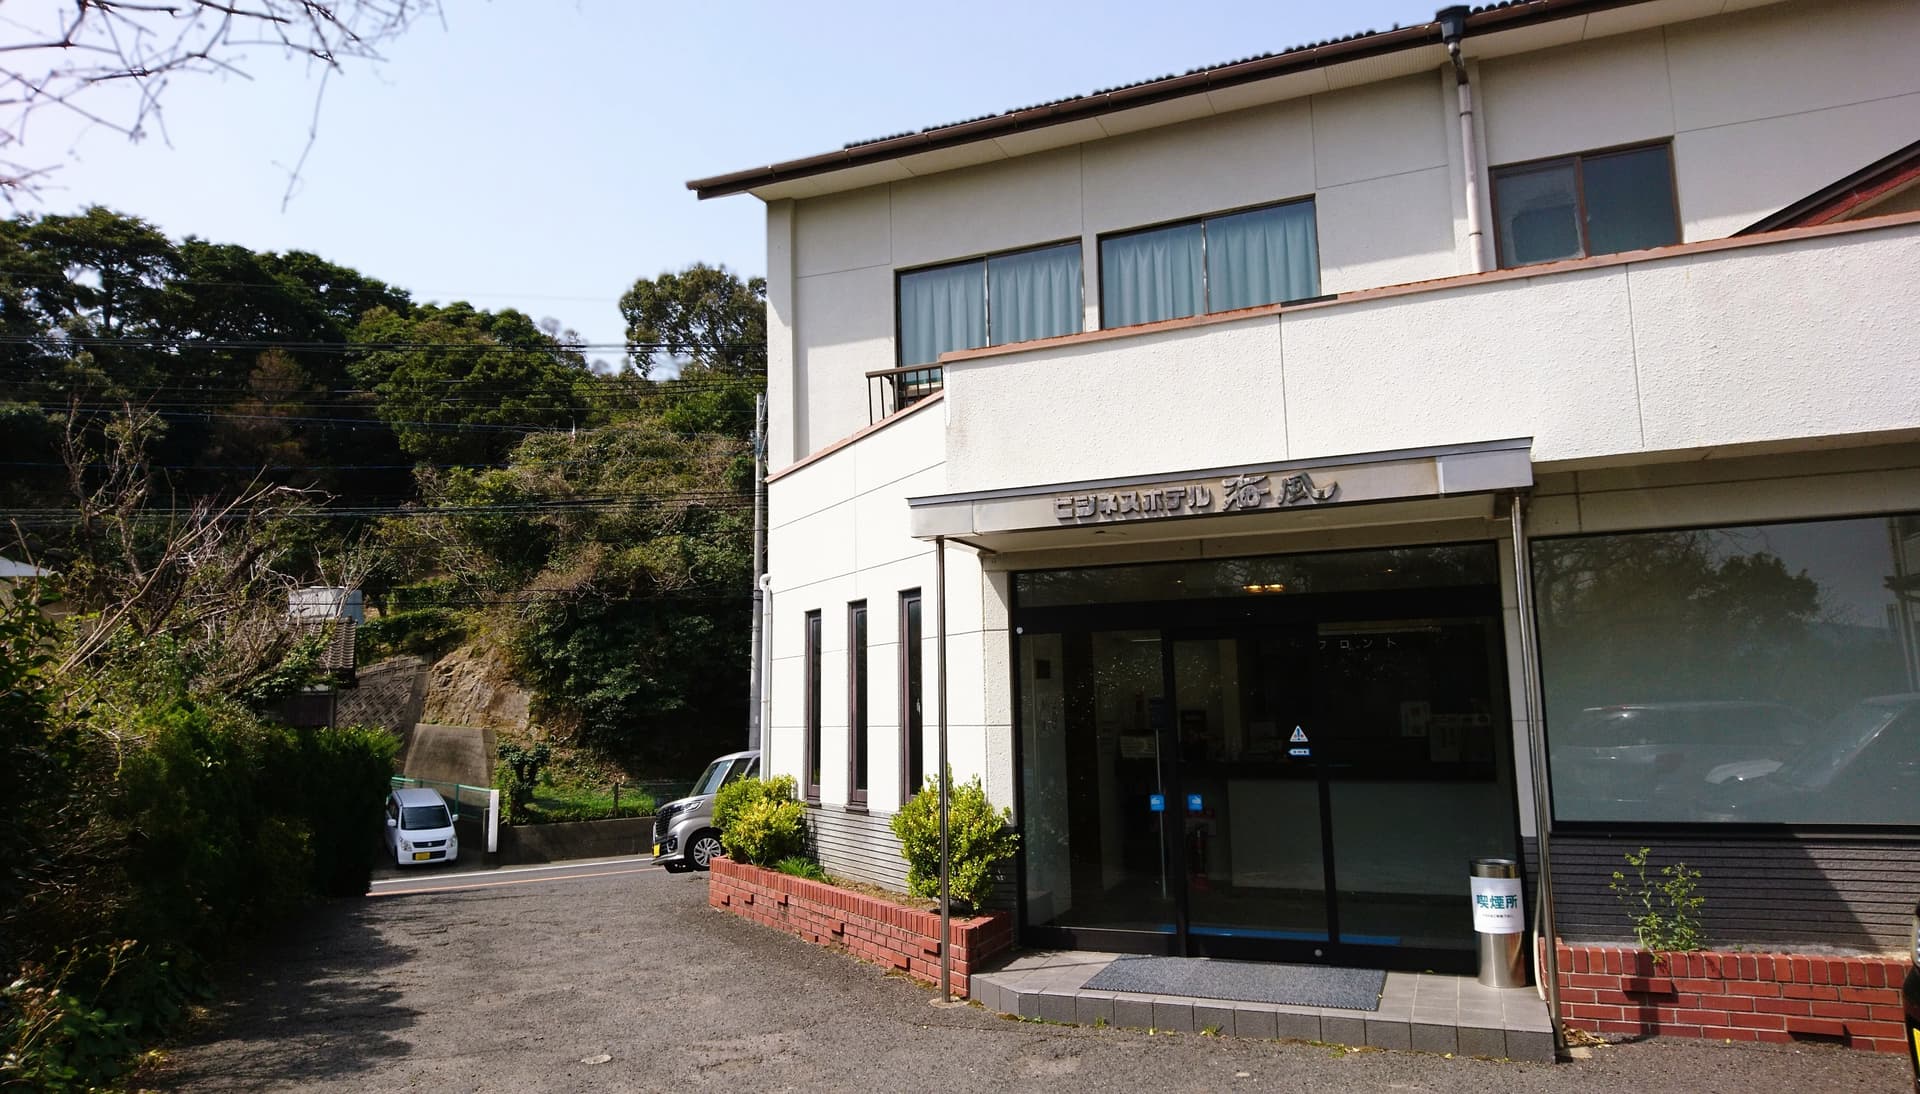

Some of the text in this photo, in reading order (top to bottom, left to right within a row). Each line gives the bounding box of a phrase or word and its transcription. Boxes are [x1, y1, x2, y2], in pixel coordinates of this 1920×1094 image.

[1056, 485, 1211, 519] ビジネスホテル
[1476, 894, 1518, 909] 喫煙所
